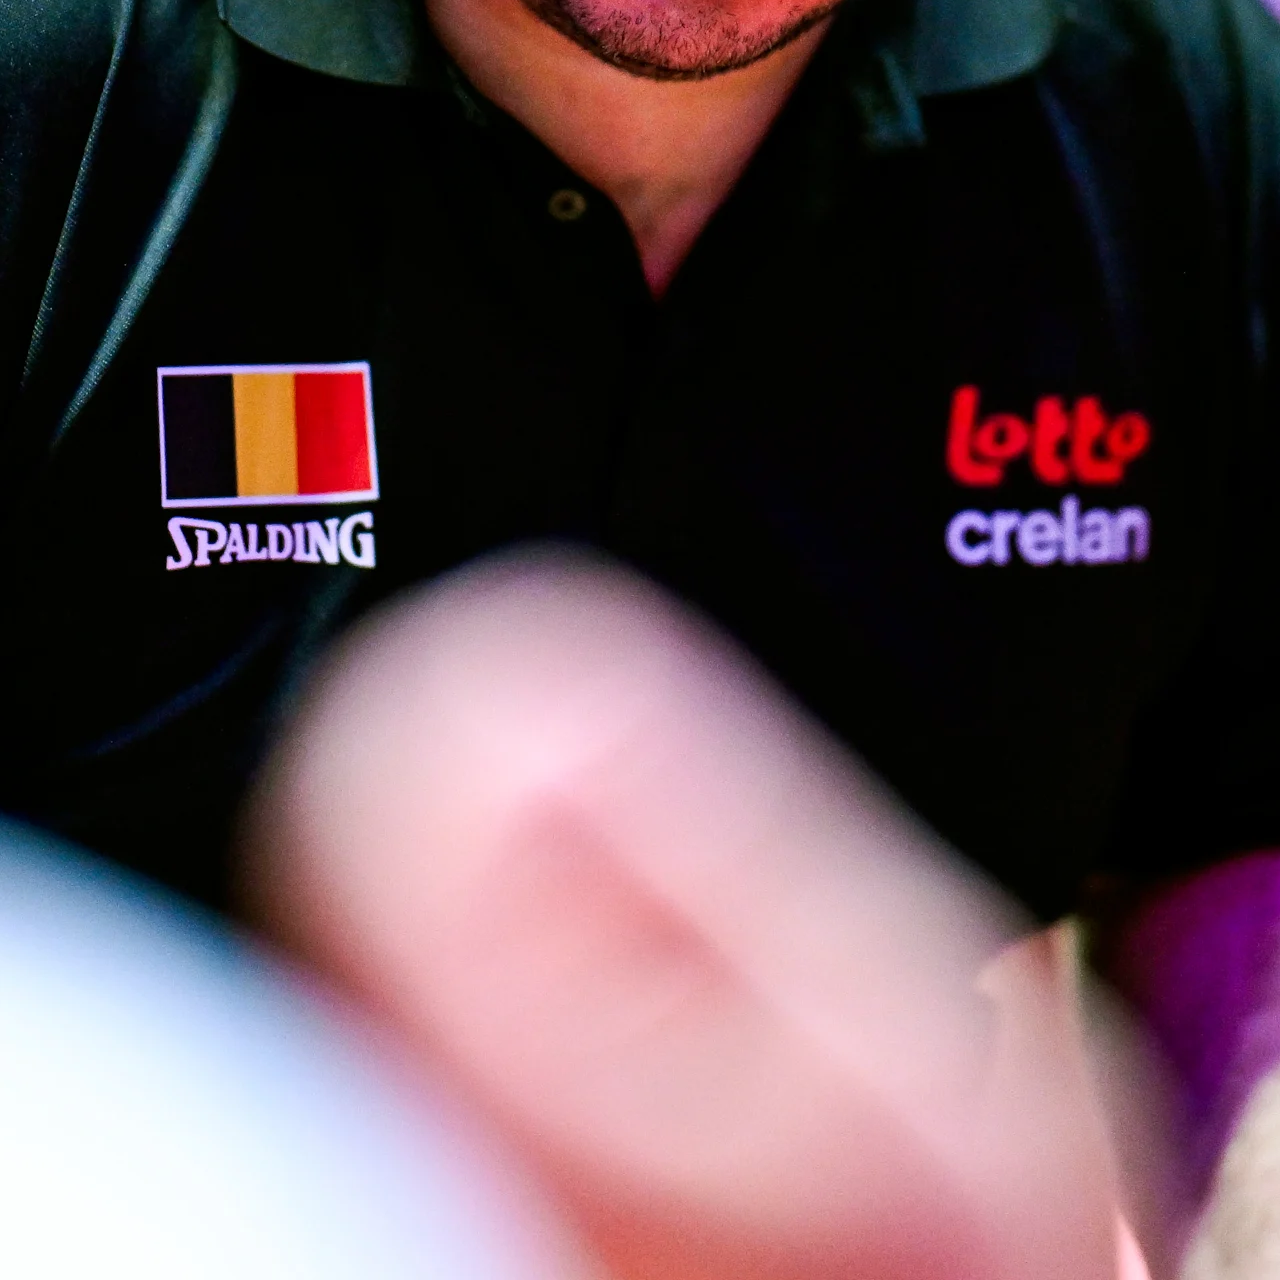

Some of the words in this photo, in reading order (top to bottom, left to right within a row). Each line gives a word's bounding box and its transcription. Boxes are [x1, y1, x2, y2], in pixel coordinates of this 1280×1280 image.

[947, 383, 1151, 488] Lotto
[166, 511, 376, 571] SPALDING
[945, 493, 1151, 567] crelan
